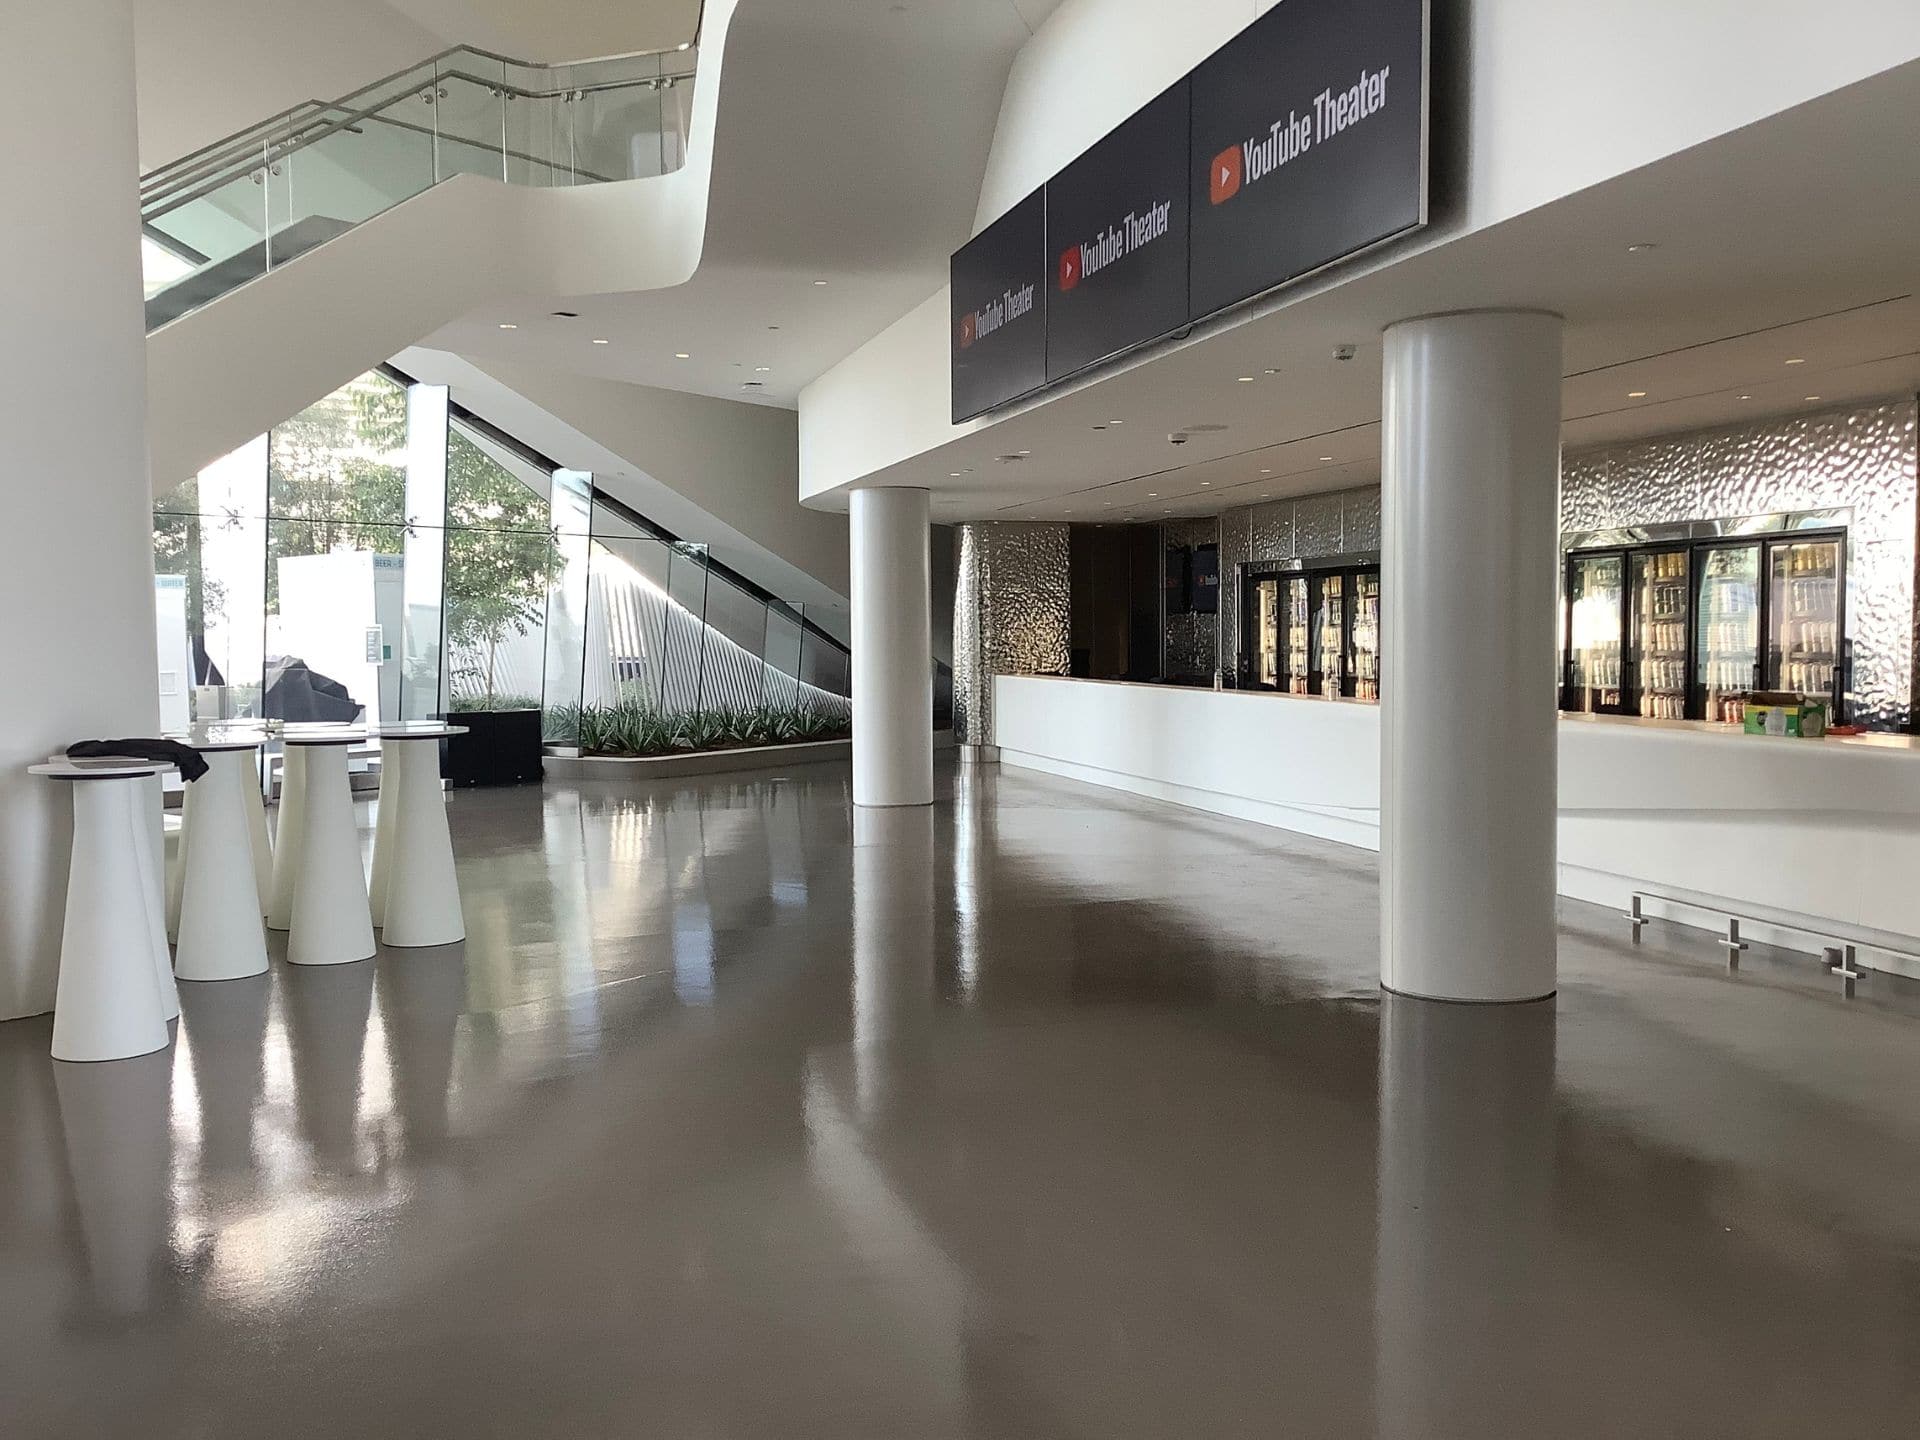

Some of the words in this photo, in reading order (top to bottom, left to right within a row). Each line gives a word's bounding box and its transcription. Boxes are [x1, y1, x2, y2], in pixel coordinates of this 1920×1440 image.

[1243, 110, 1311, 185] YouTube
[1313, 65, 1390, 144] Theater
[1080, 225, 1123, 279] YouTube
[1123, 200, 1170, 254] Theater
[974, 299, 1004, 340] YouTube
[1003, 283, 1034, 323] Theater
